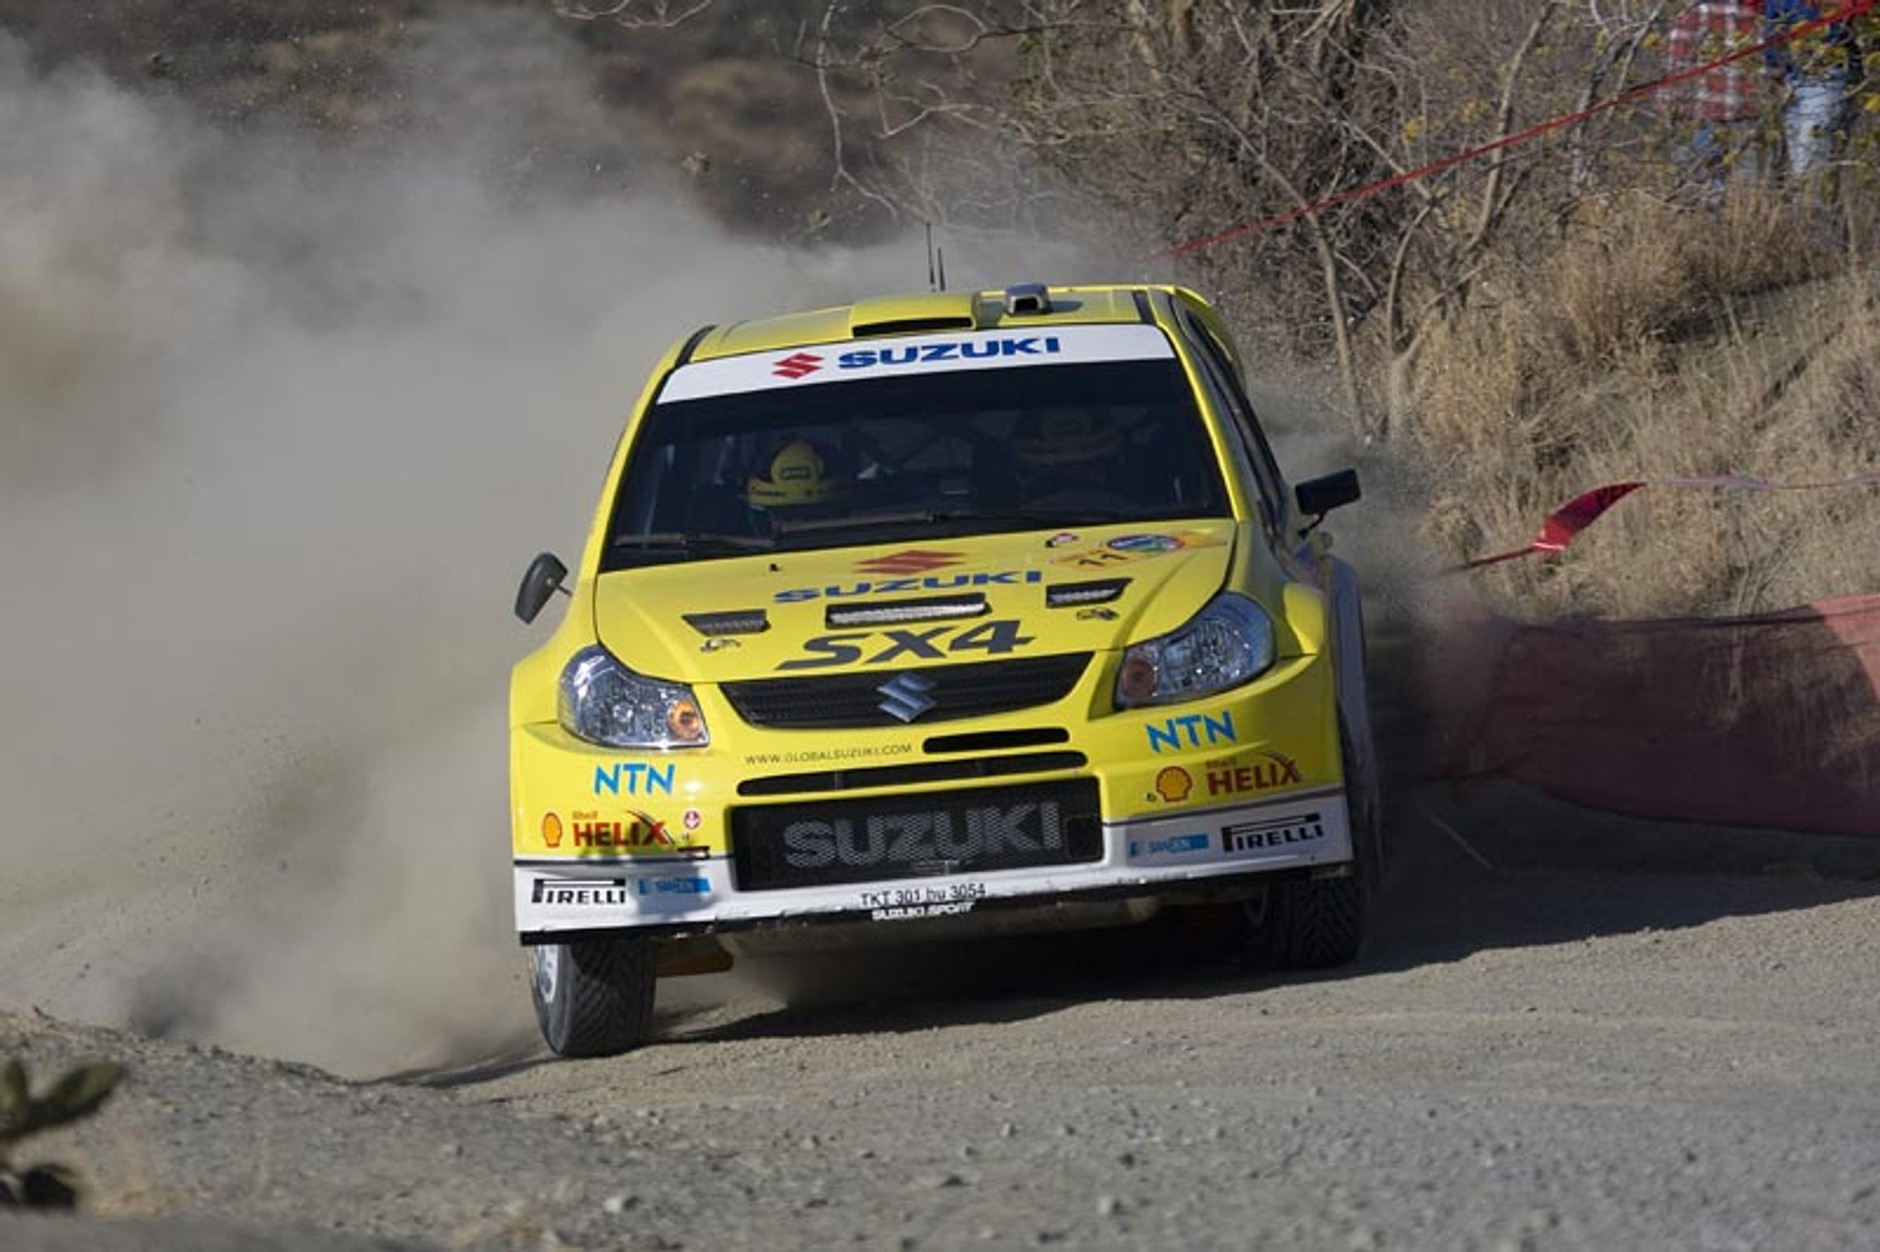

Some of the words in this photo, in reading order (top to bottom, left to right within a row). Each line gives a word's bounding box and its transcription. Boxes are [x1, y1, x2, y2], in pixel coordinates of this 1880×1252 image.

[838, 335, 1061, 370] SUZUKI
[774, 570, 1042, 602] SUZUKI
[774, 619, 1036, 670] SX4
[1146, 711, 1236, 752] NTN
[594, 763, 675, 794] NTN
[1207, 757, 1300, 795] HELIX
[572, 814, 671, 847] HELIX
[784, 802, 1062, 868] SUZUKI
[1221, 813, 1324, 852] PIRELLI
[532, 878, 626, 904] PIRELLI
[860, 891, 891, 907] TKT
